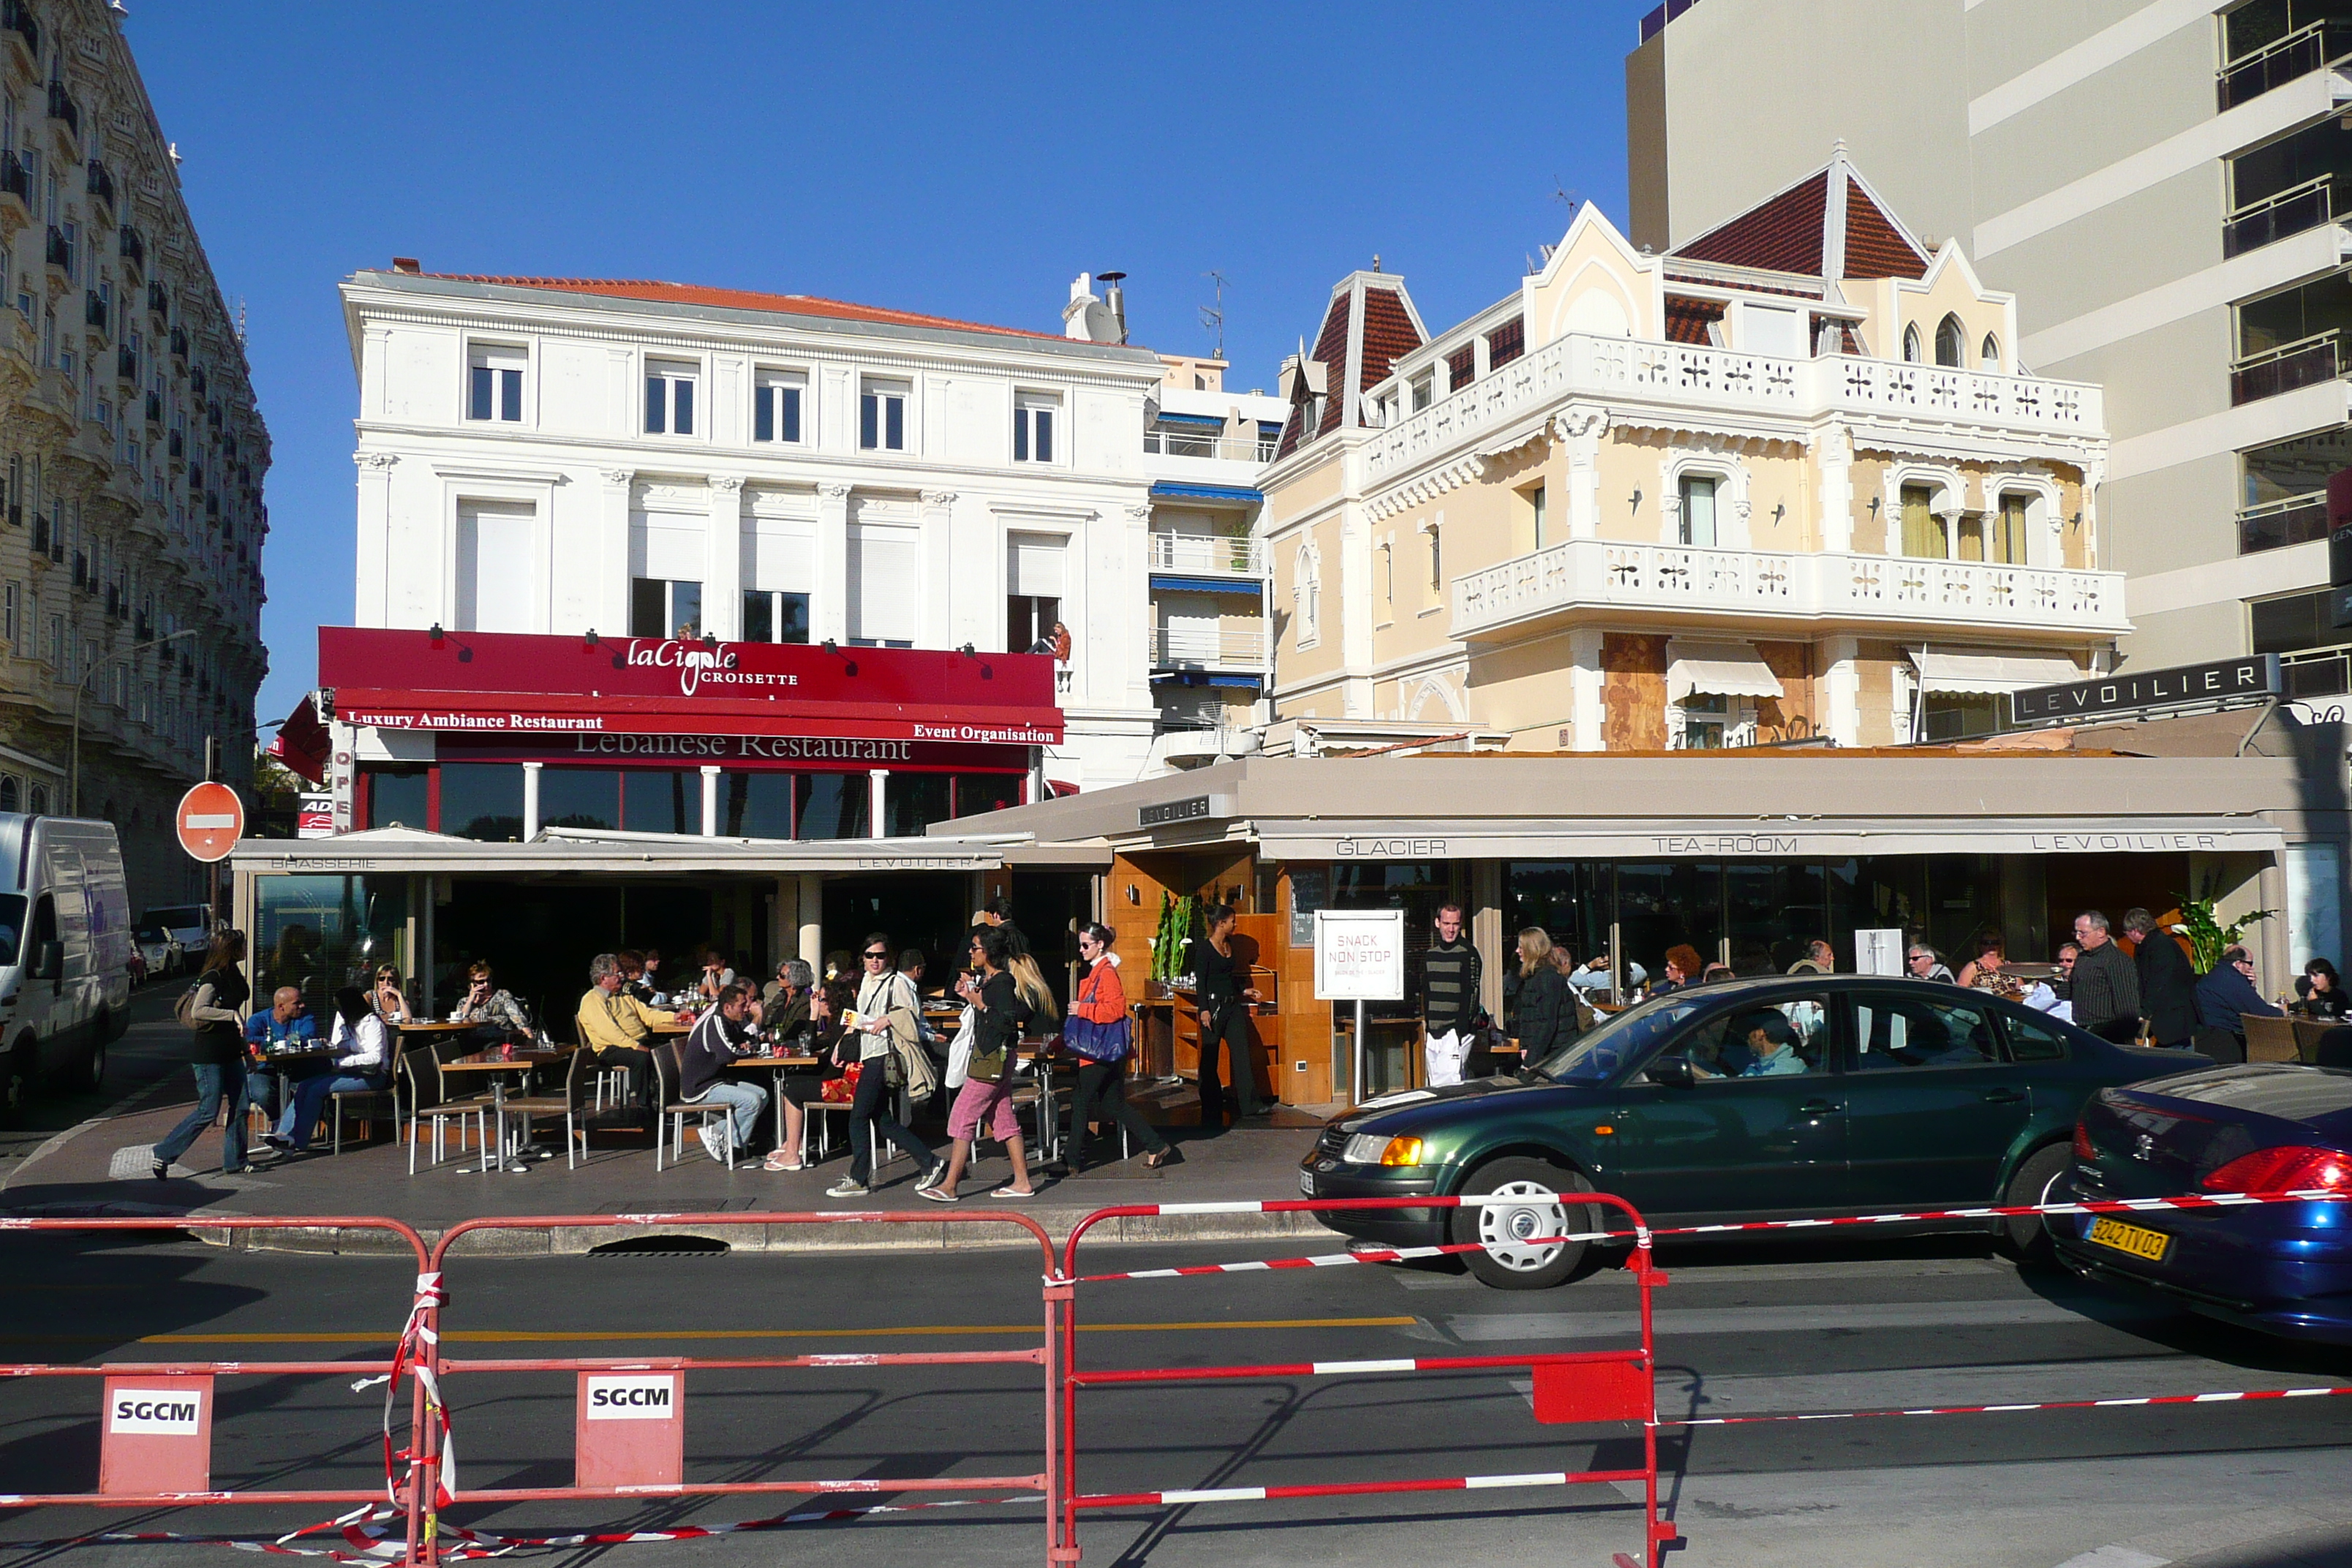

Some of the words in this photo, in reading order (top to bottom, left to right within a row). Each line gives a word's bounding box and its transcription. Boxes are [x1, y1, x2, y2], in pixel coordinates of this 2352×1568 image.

[701, 672, 798, 685] CROISETTE
[347, 712, 414, 729] Luxury
[418, 713, 505, 728] Ambiance
[510, 715, 603, 729] Restaurant
[913, 725, 957, 738] Event
[960, 726, 1054, 742] Organisation
[574, 733, 727, 755] Lebanese
[737, 736, 911, 761] Restaurant
[335, 752, 350, 834] OPEN
[303, 802, 333, 812] AD
[1336, 840, 1447, 856] GLACIER
[1651, 837, 1798, 853] TEA-ROOM
[271, 859, 377, 869] BRASSERIE
[1338, 935, 1378, 946] SNACK
[1329, 951, 1354, 962] NON
[1360, 951, 1390, 962] STOP
[2141, 1233, 2164, 1256] 03
[592, 1388, 669, 1406] SGCM
[117, 1401, 196, 1421] SGCM
